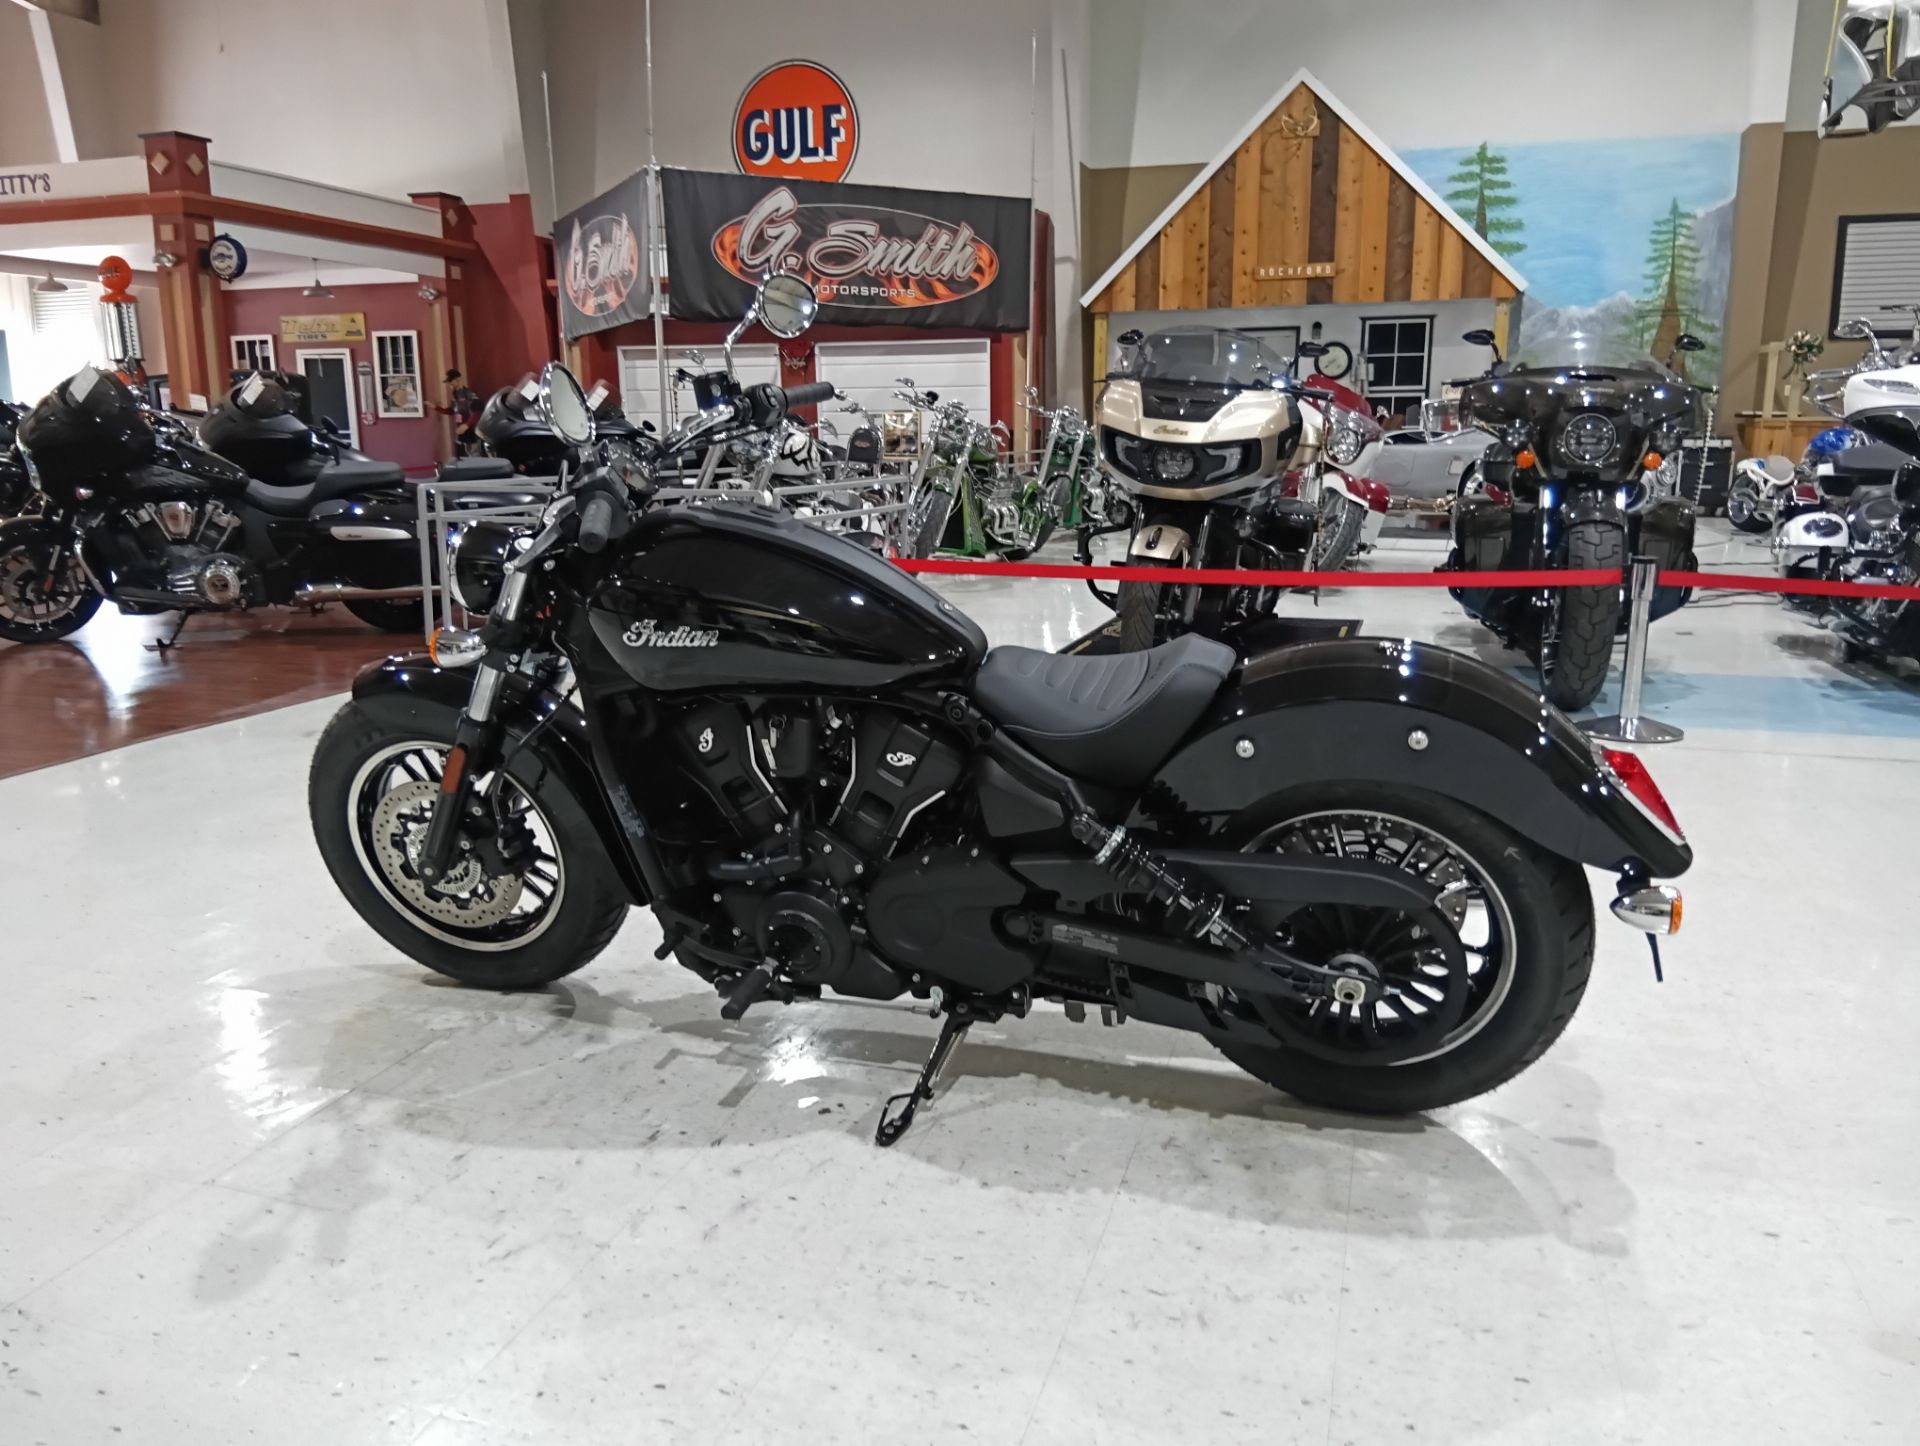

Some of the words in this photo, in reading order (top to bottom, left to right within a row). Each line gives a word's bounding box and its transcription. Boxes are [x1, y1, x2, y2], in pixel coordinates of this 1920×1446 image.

[743, 104, 847, 166] GULF
[806, 221, 978, 281] Smith
[622, 618, 719, 648] Indian
